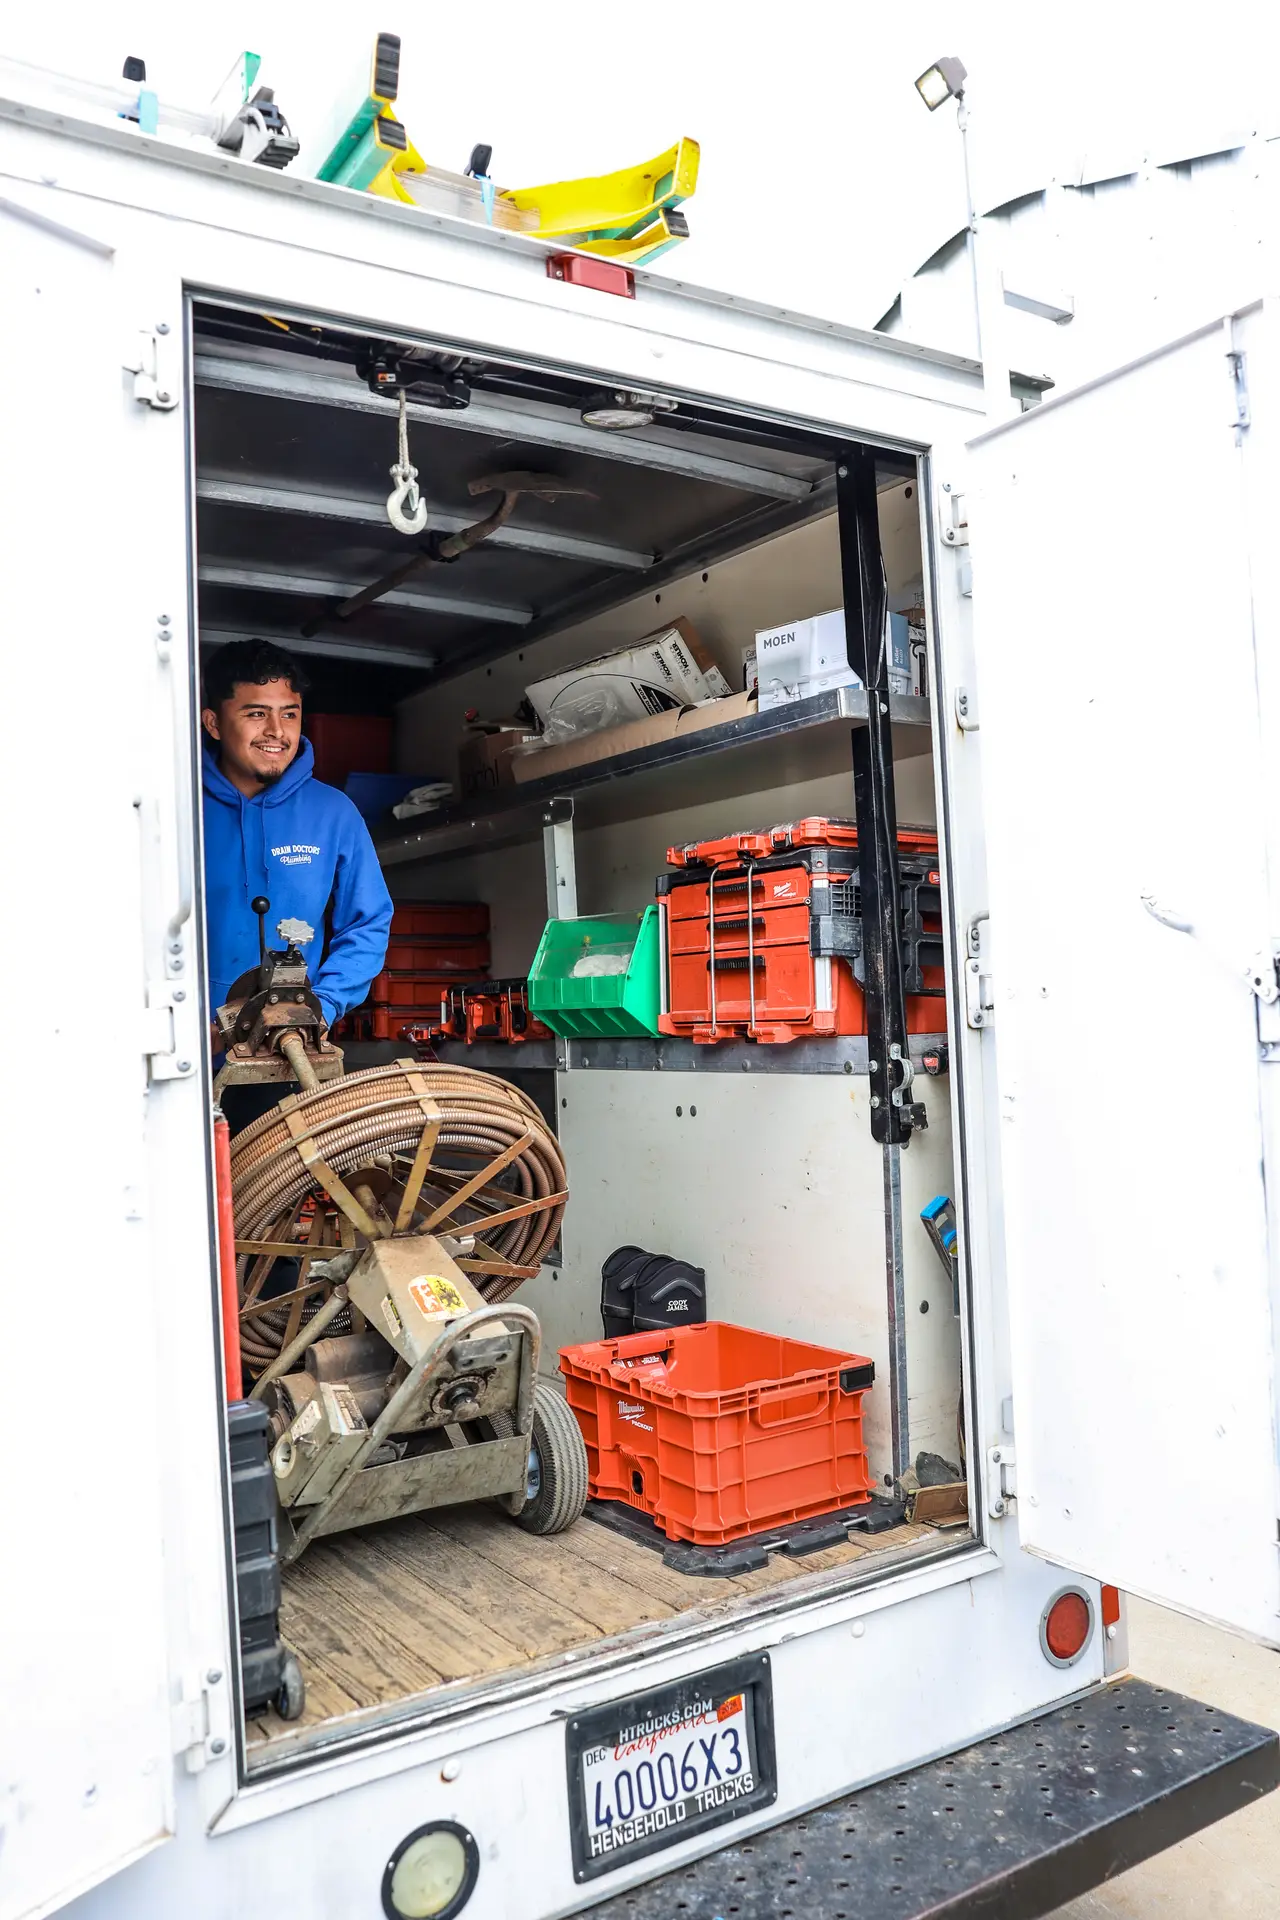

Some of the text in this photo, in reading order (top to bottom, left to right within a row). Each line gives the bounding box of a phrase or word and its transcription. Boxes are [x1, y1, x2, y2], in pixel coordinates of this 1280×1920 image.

[763, 632, 795, 649] MOEN
[271, 845, 291, 856] DRAIN
[666, 1304, 689, 1312] JAMES
[617, 1400, 645, 1414] Milwaukee
[619, 1698, 713, 1744] HTRUCKS.COM
[586, 1747, 607, 1767] DEC
[594, 1727, 743, 1829] 40006X3
[590, 1772, 755, 1857] HENGEHOLD TRUCKS
